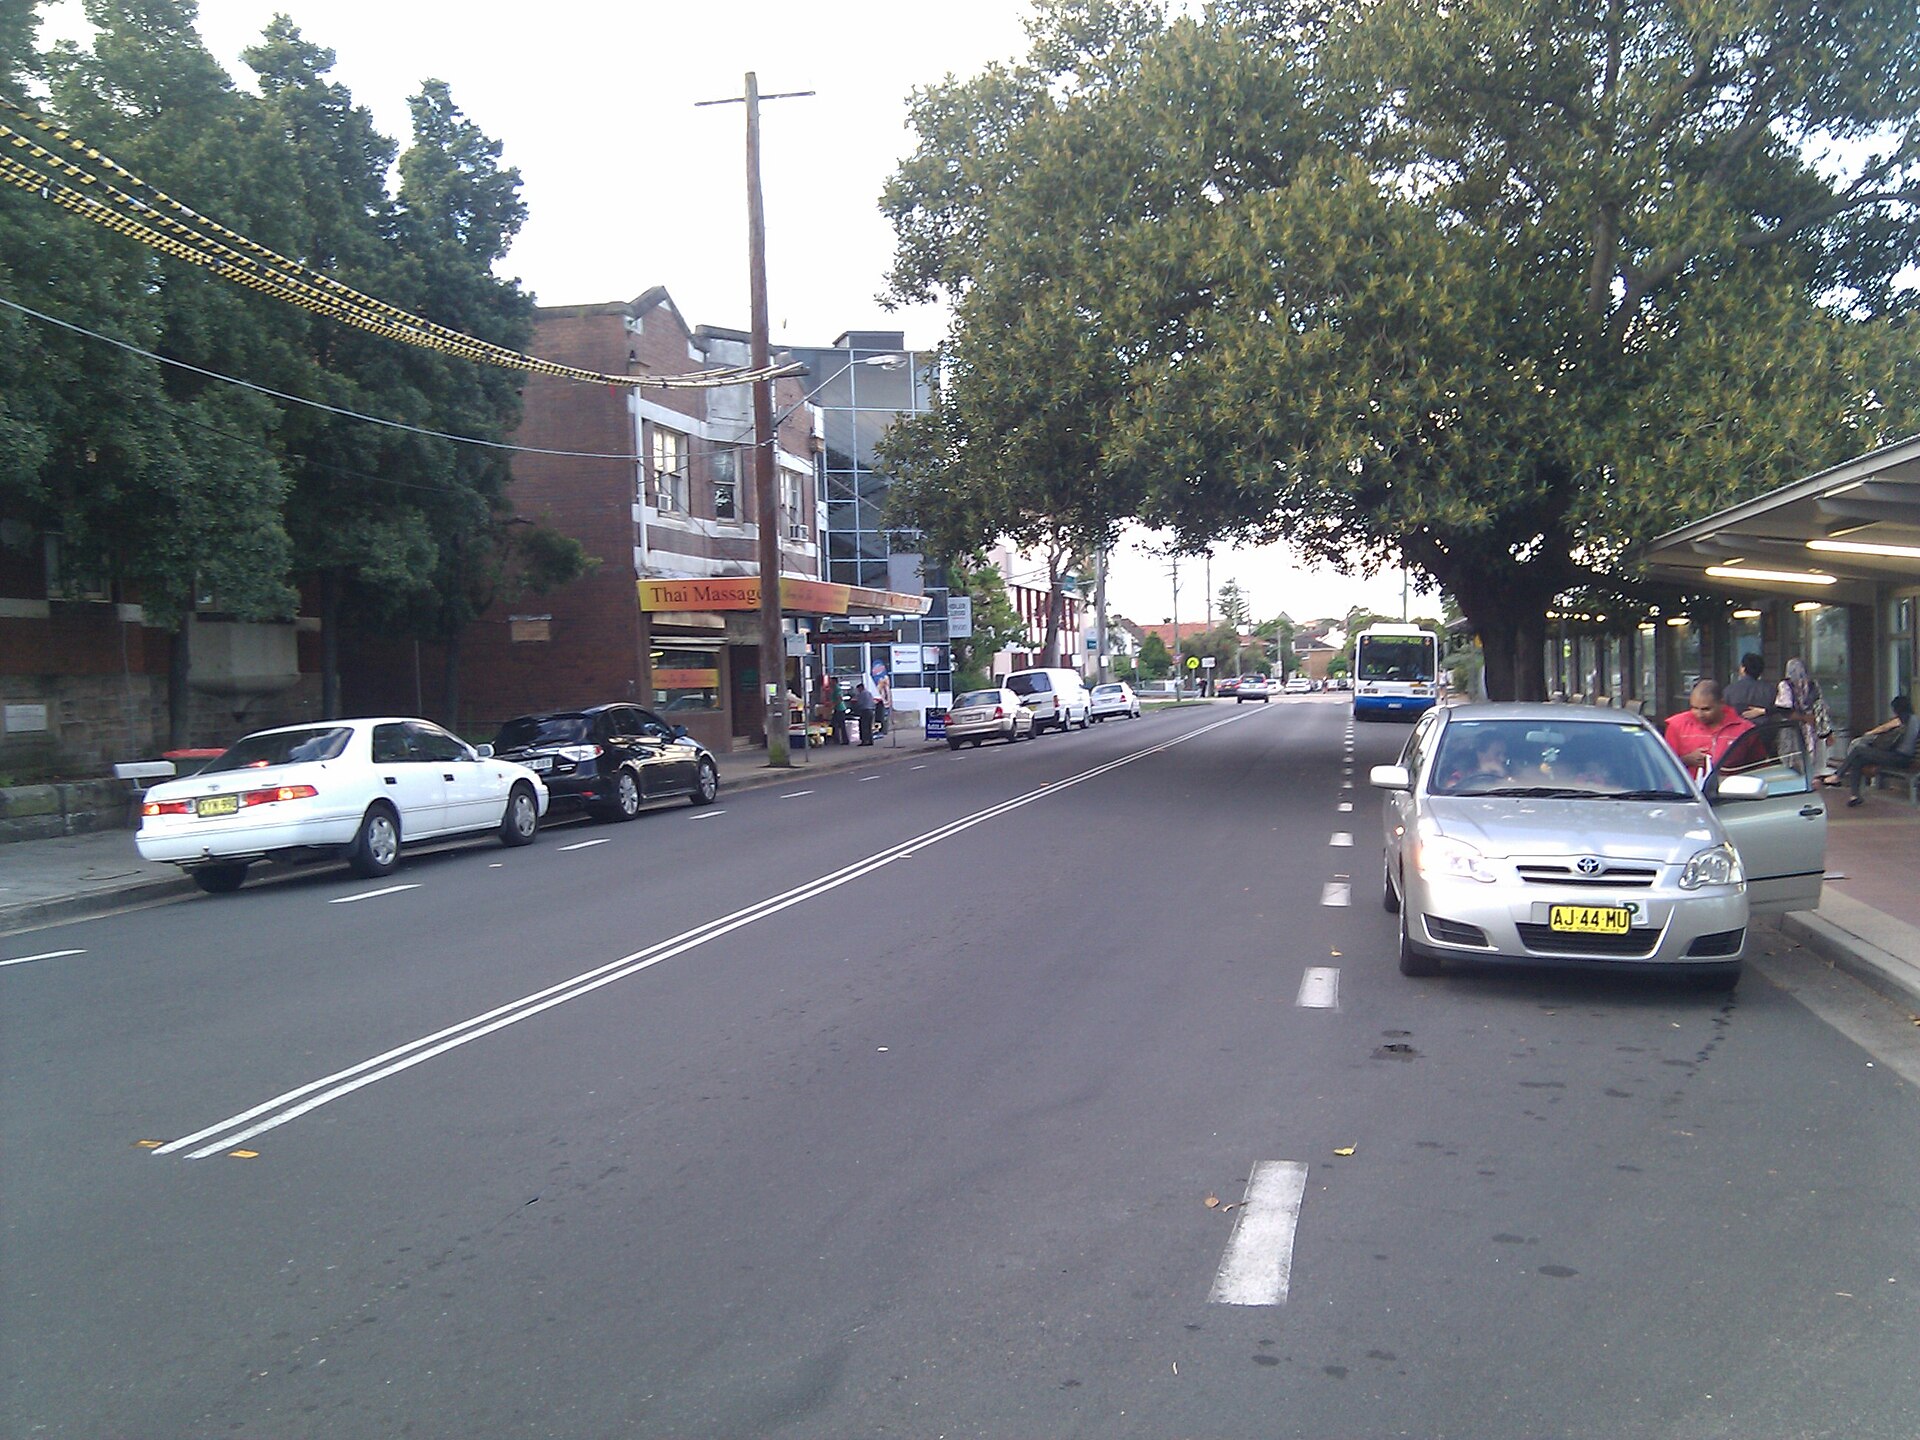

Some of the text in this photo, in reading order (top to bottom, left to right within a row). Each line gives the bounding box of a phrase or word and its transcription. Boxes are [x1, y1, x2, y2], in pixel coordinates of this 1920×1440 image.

[650, 586, 688, 603] Thai
[1553, 908, 1629, 929] AJ 44 MU
